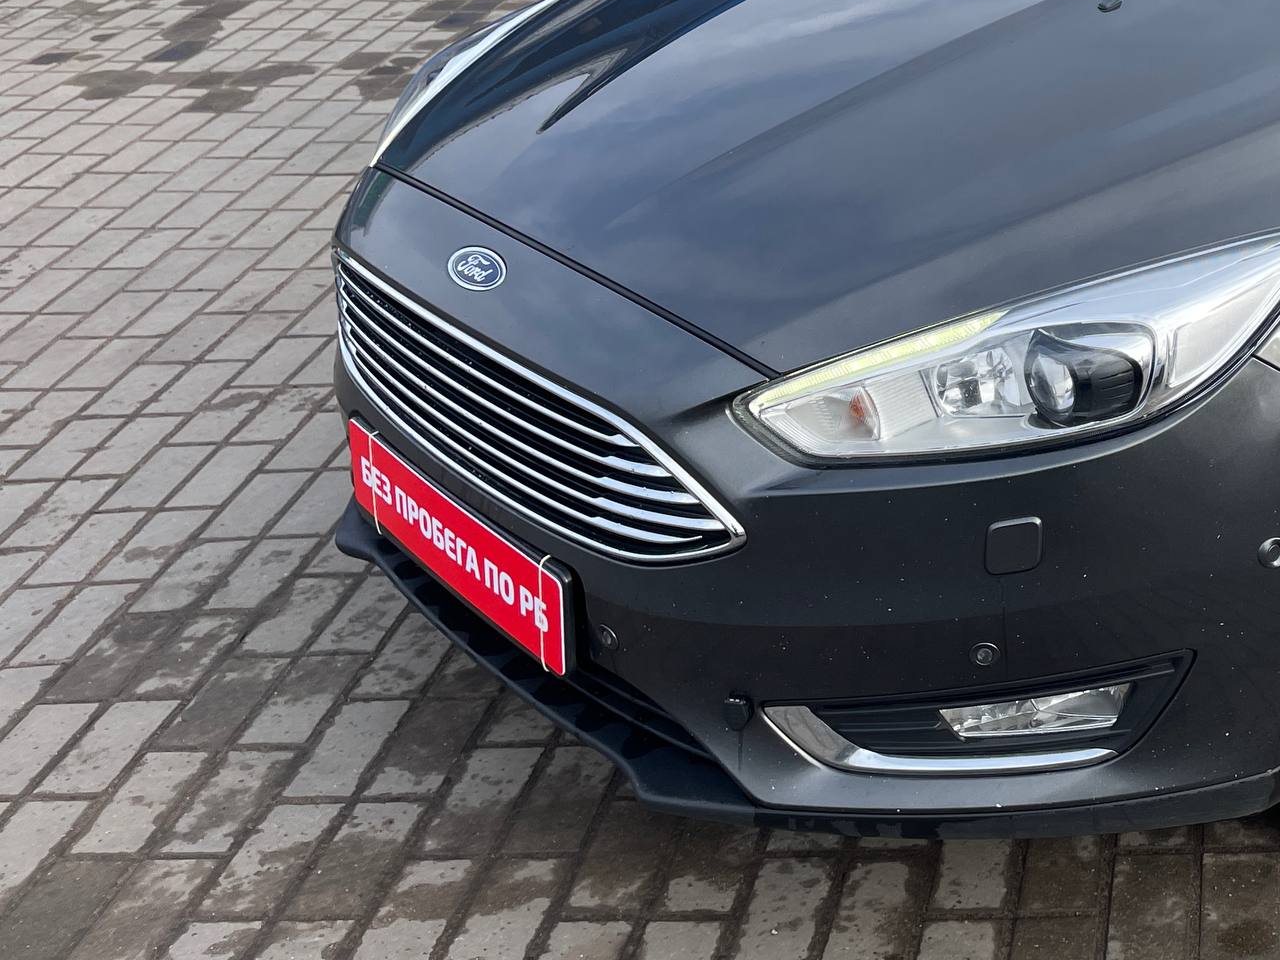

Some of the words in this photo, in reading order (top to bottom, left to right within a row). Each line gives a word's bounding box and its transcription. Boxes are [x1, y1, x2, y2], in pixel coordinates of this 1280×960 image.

[457, 254, 494, 282] Ford
[360, 456, 393, 505] БЕЗ
[395, 485, 481, 581] ПРОБЕГА
[484, 558, 515, 606] ПО
[519, 585, 549, 632] РБ
